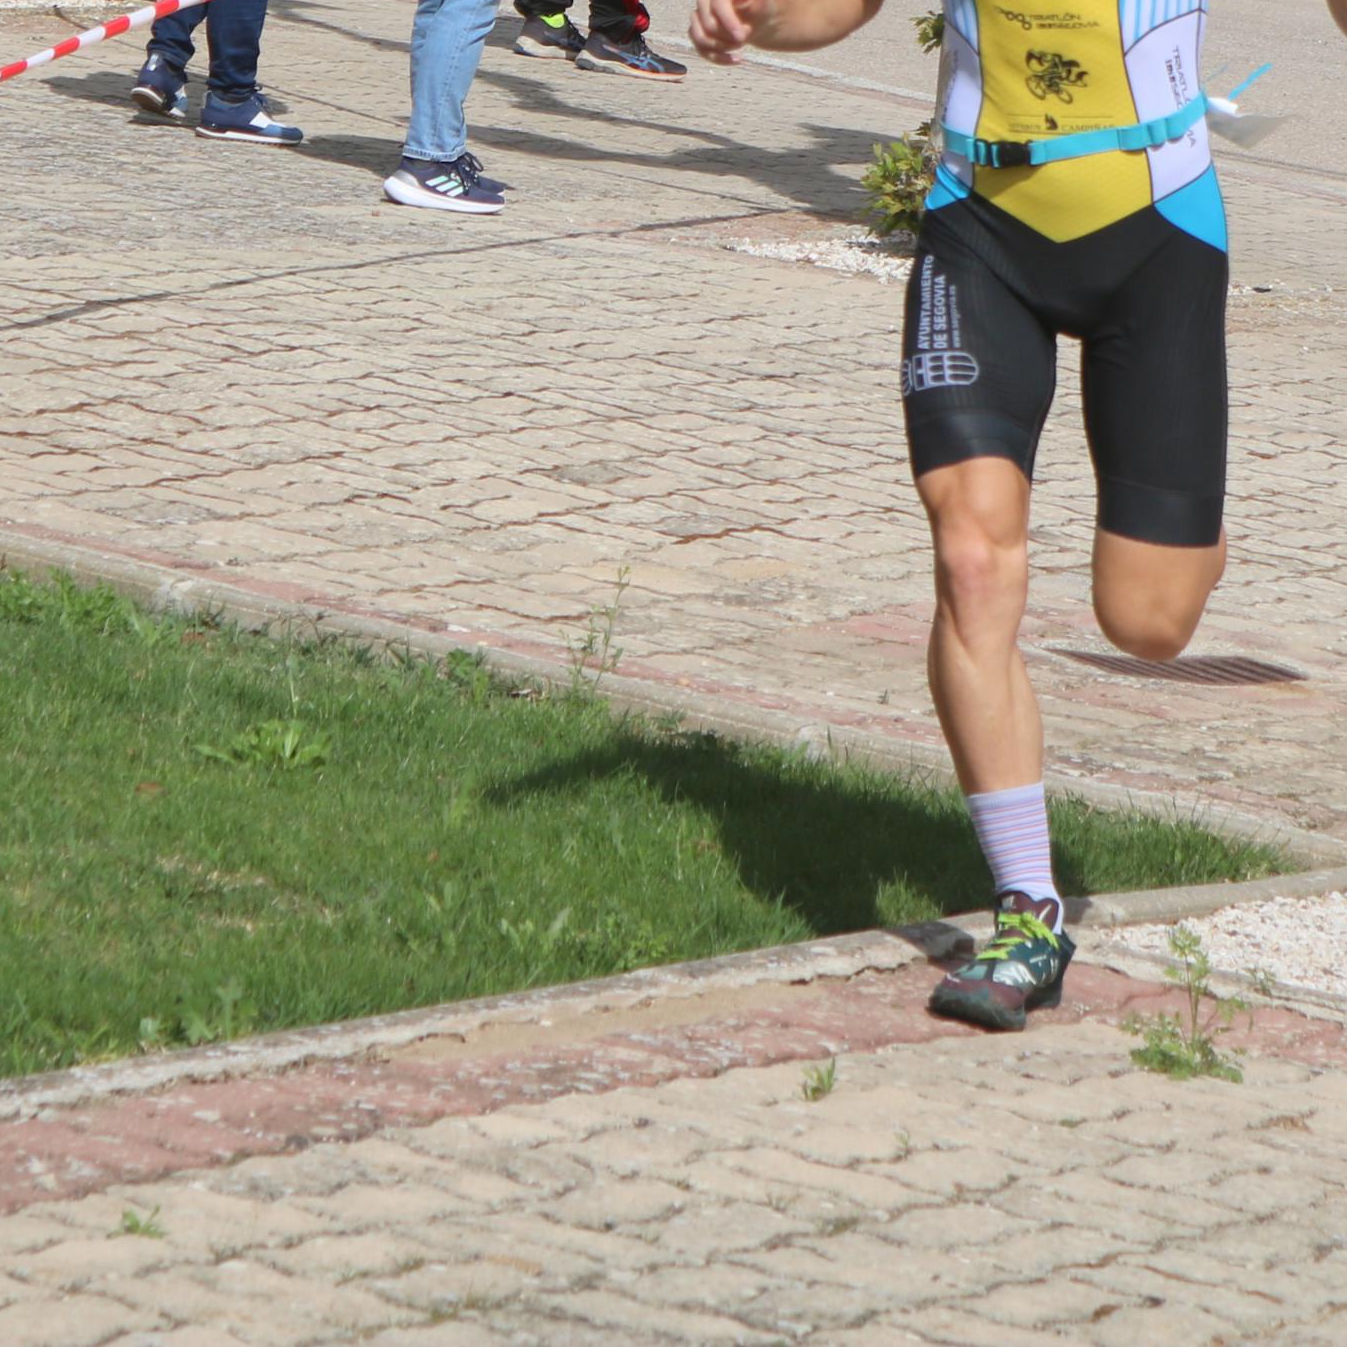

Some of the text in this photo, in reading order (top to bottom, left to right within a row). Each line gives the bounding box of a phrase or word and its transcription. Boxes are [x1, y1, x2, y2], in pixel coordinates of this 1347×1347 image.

[917, 254, 934, 349] AYUNTAMIENTO
[933, 274, 948, 349] DE SEGOVIA
